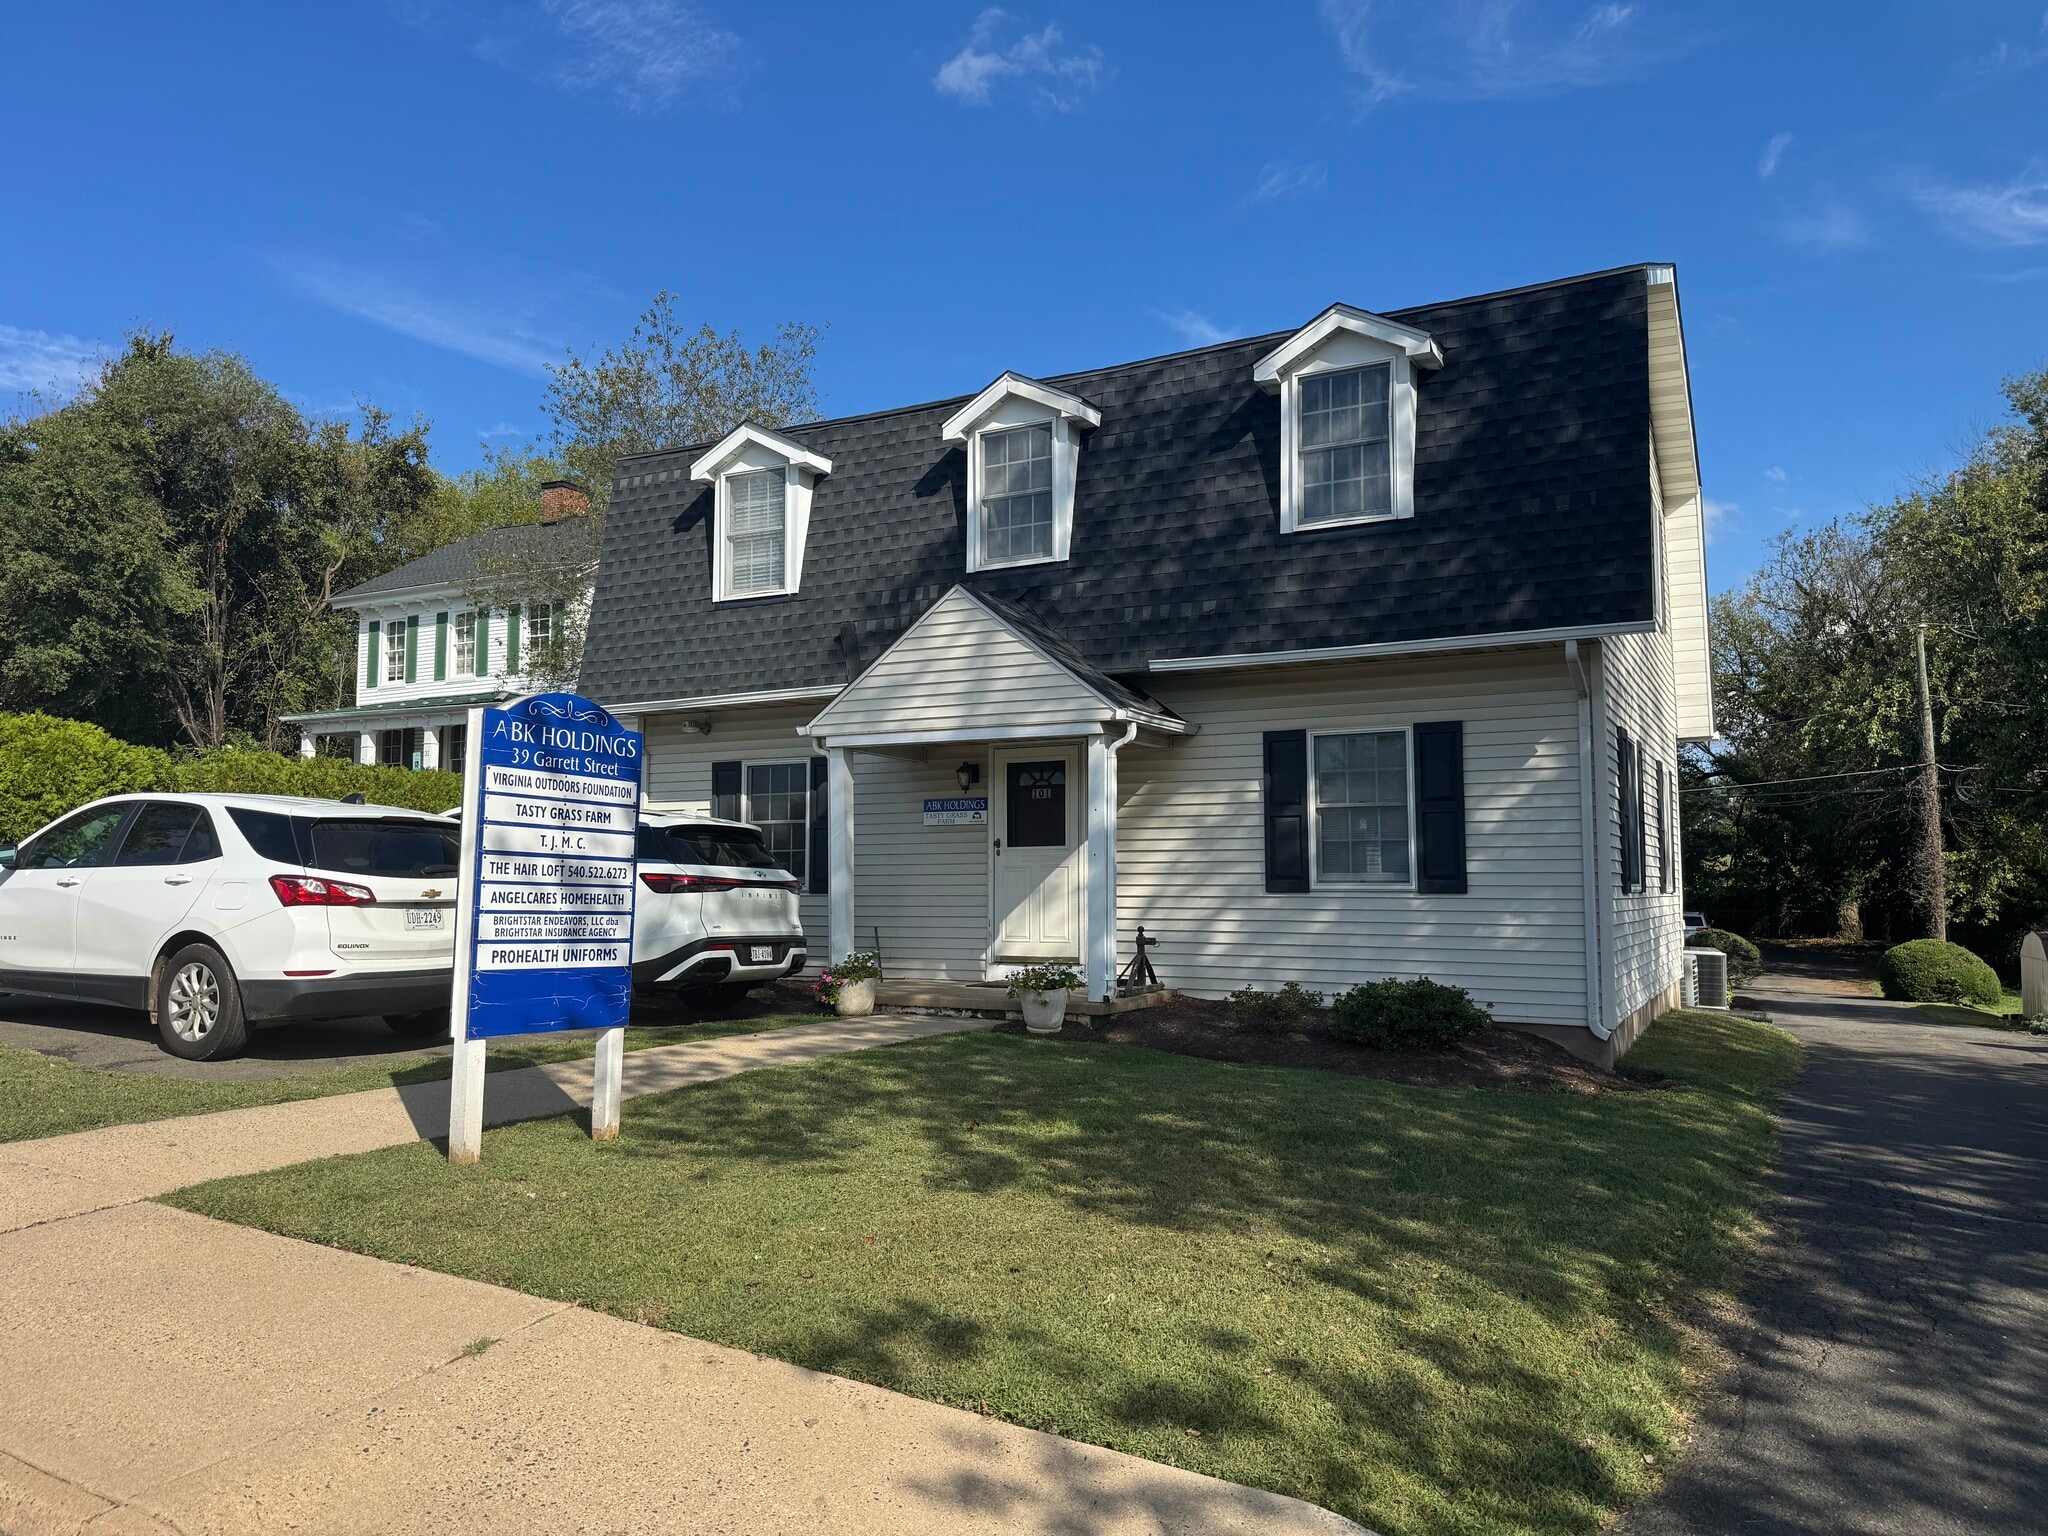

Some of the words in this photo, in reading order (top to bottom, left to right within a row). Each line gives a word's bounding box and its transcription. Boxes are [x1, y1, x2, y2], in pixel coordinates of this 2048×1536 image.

[493, 720, 536, 744] ABK
[542, 726, 636, 758] HOLDINGS
[511, 748, 530, 764] 39
[533, 751, 580, 771] Garrett
[584, 757, 619, 776] Street
[493, 772, 533, 789] VIRGINIA
[535, 776, 581, 794] OUTDOORS
[583, 782, 632, 799] FOUNDATION
[1032, 789, 1051, 798] 101
[926, 801, 942, 811] ABK
[943, 800, 985, 810] HOLDINGS
[516, 803, 547, 819] TASTY
[550, 807, 582, 822] GRASS
[585, 810, 611, 824] FARM
[540, 835, 548, 847] T.
[550, 835, 558, 851] J.
[562, 837, 573, 849] M.
[577, 837, 586, 849] C.
[489, 861, 510, 875] THE
[514, 862, 538, 876] HAIR
[541, 864, 565, 877] LOFT
[568, 865, 627, 880] 540.522.6273
[490, 891, 557, 904] ANGELCARES
[561, 892, 624, 905] HOMEHEALTH
[493, 916, 541, 926] BRIGHTSTAR
[544, 916, 589, 927] ENDEAVORS,
[591, 917, 604, 926] LLC
[606, 918, 619, 926] dba
[494, 928, 542, 937] BRIGHTSTAR
[545, 928, 586, 937] INSURANCE
[588, 927, 617, 937] AGENCY
[491, 949, 559, 963] PROHEALTH
[562, 948, 618, 962] UNIFORMS
